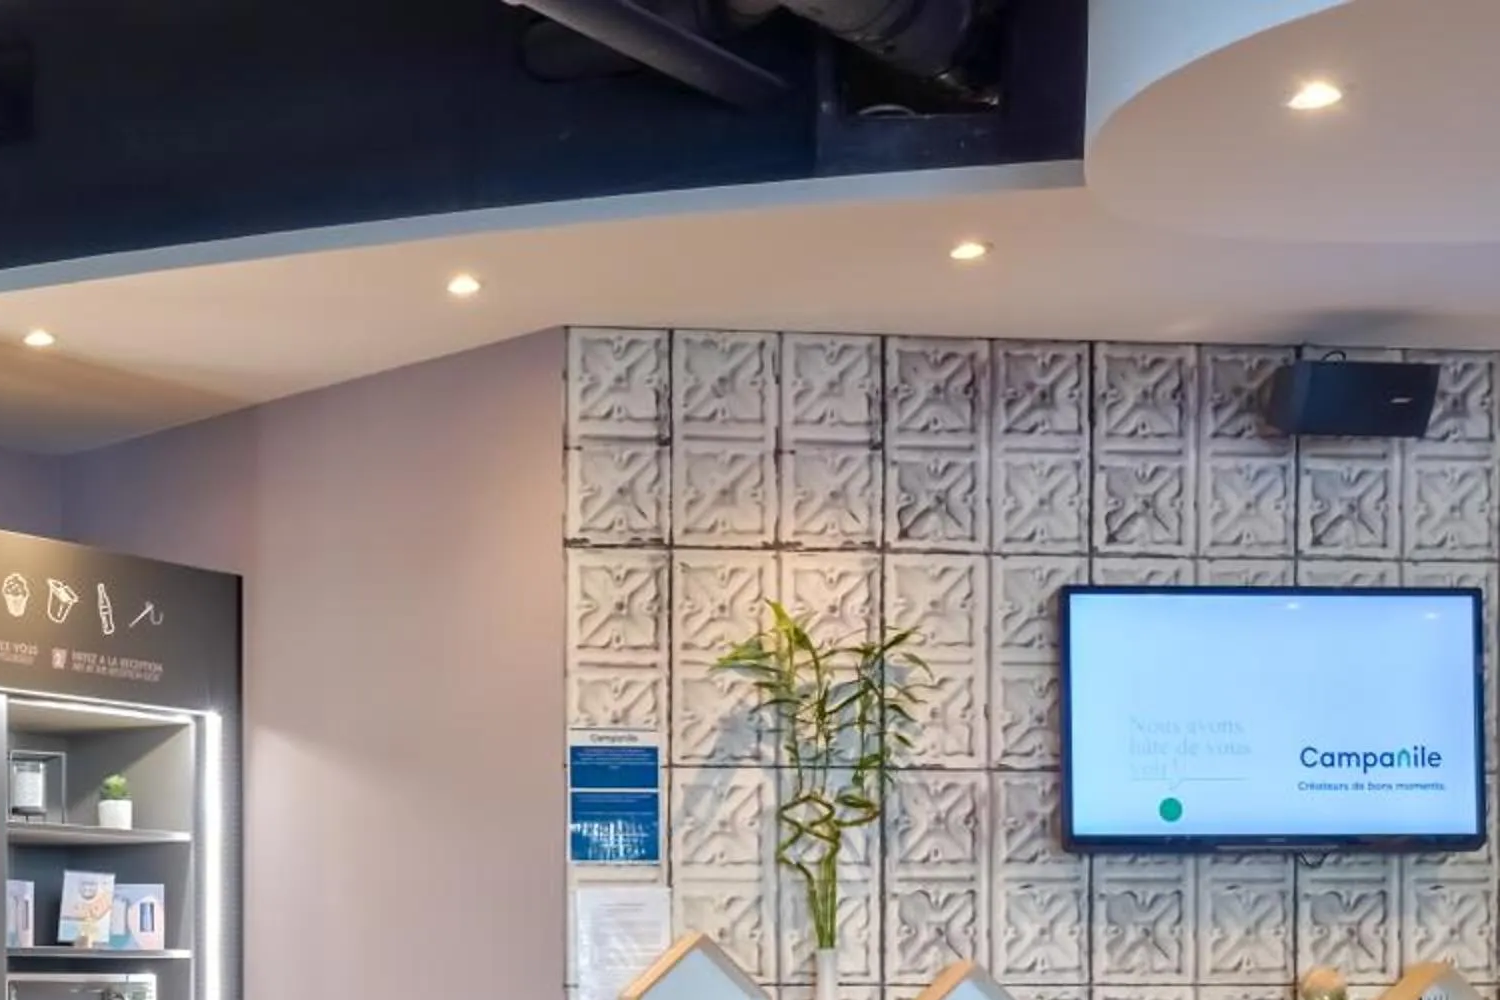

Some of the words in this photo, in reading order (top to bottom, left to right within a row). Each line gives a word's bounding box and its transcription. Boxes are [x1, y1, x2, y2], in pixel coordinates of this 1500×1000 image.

[1299, 746, 1443, 773] Campanile
[1352, 780, 1365, 791] de
[1367, 780, 1393, 791] bons
